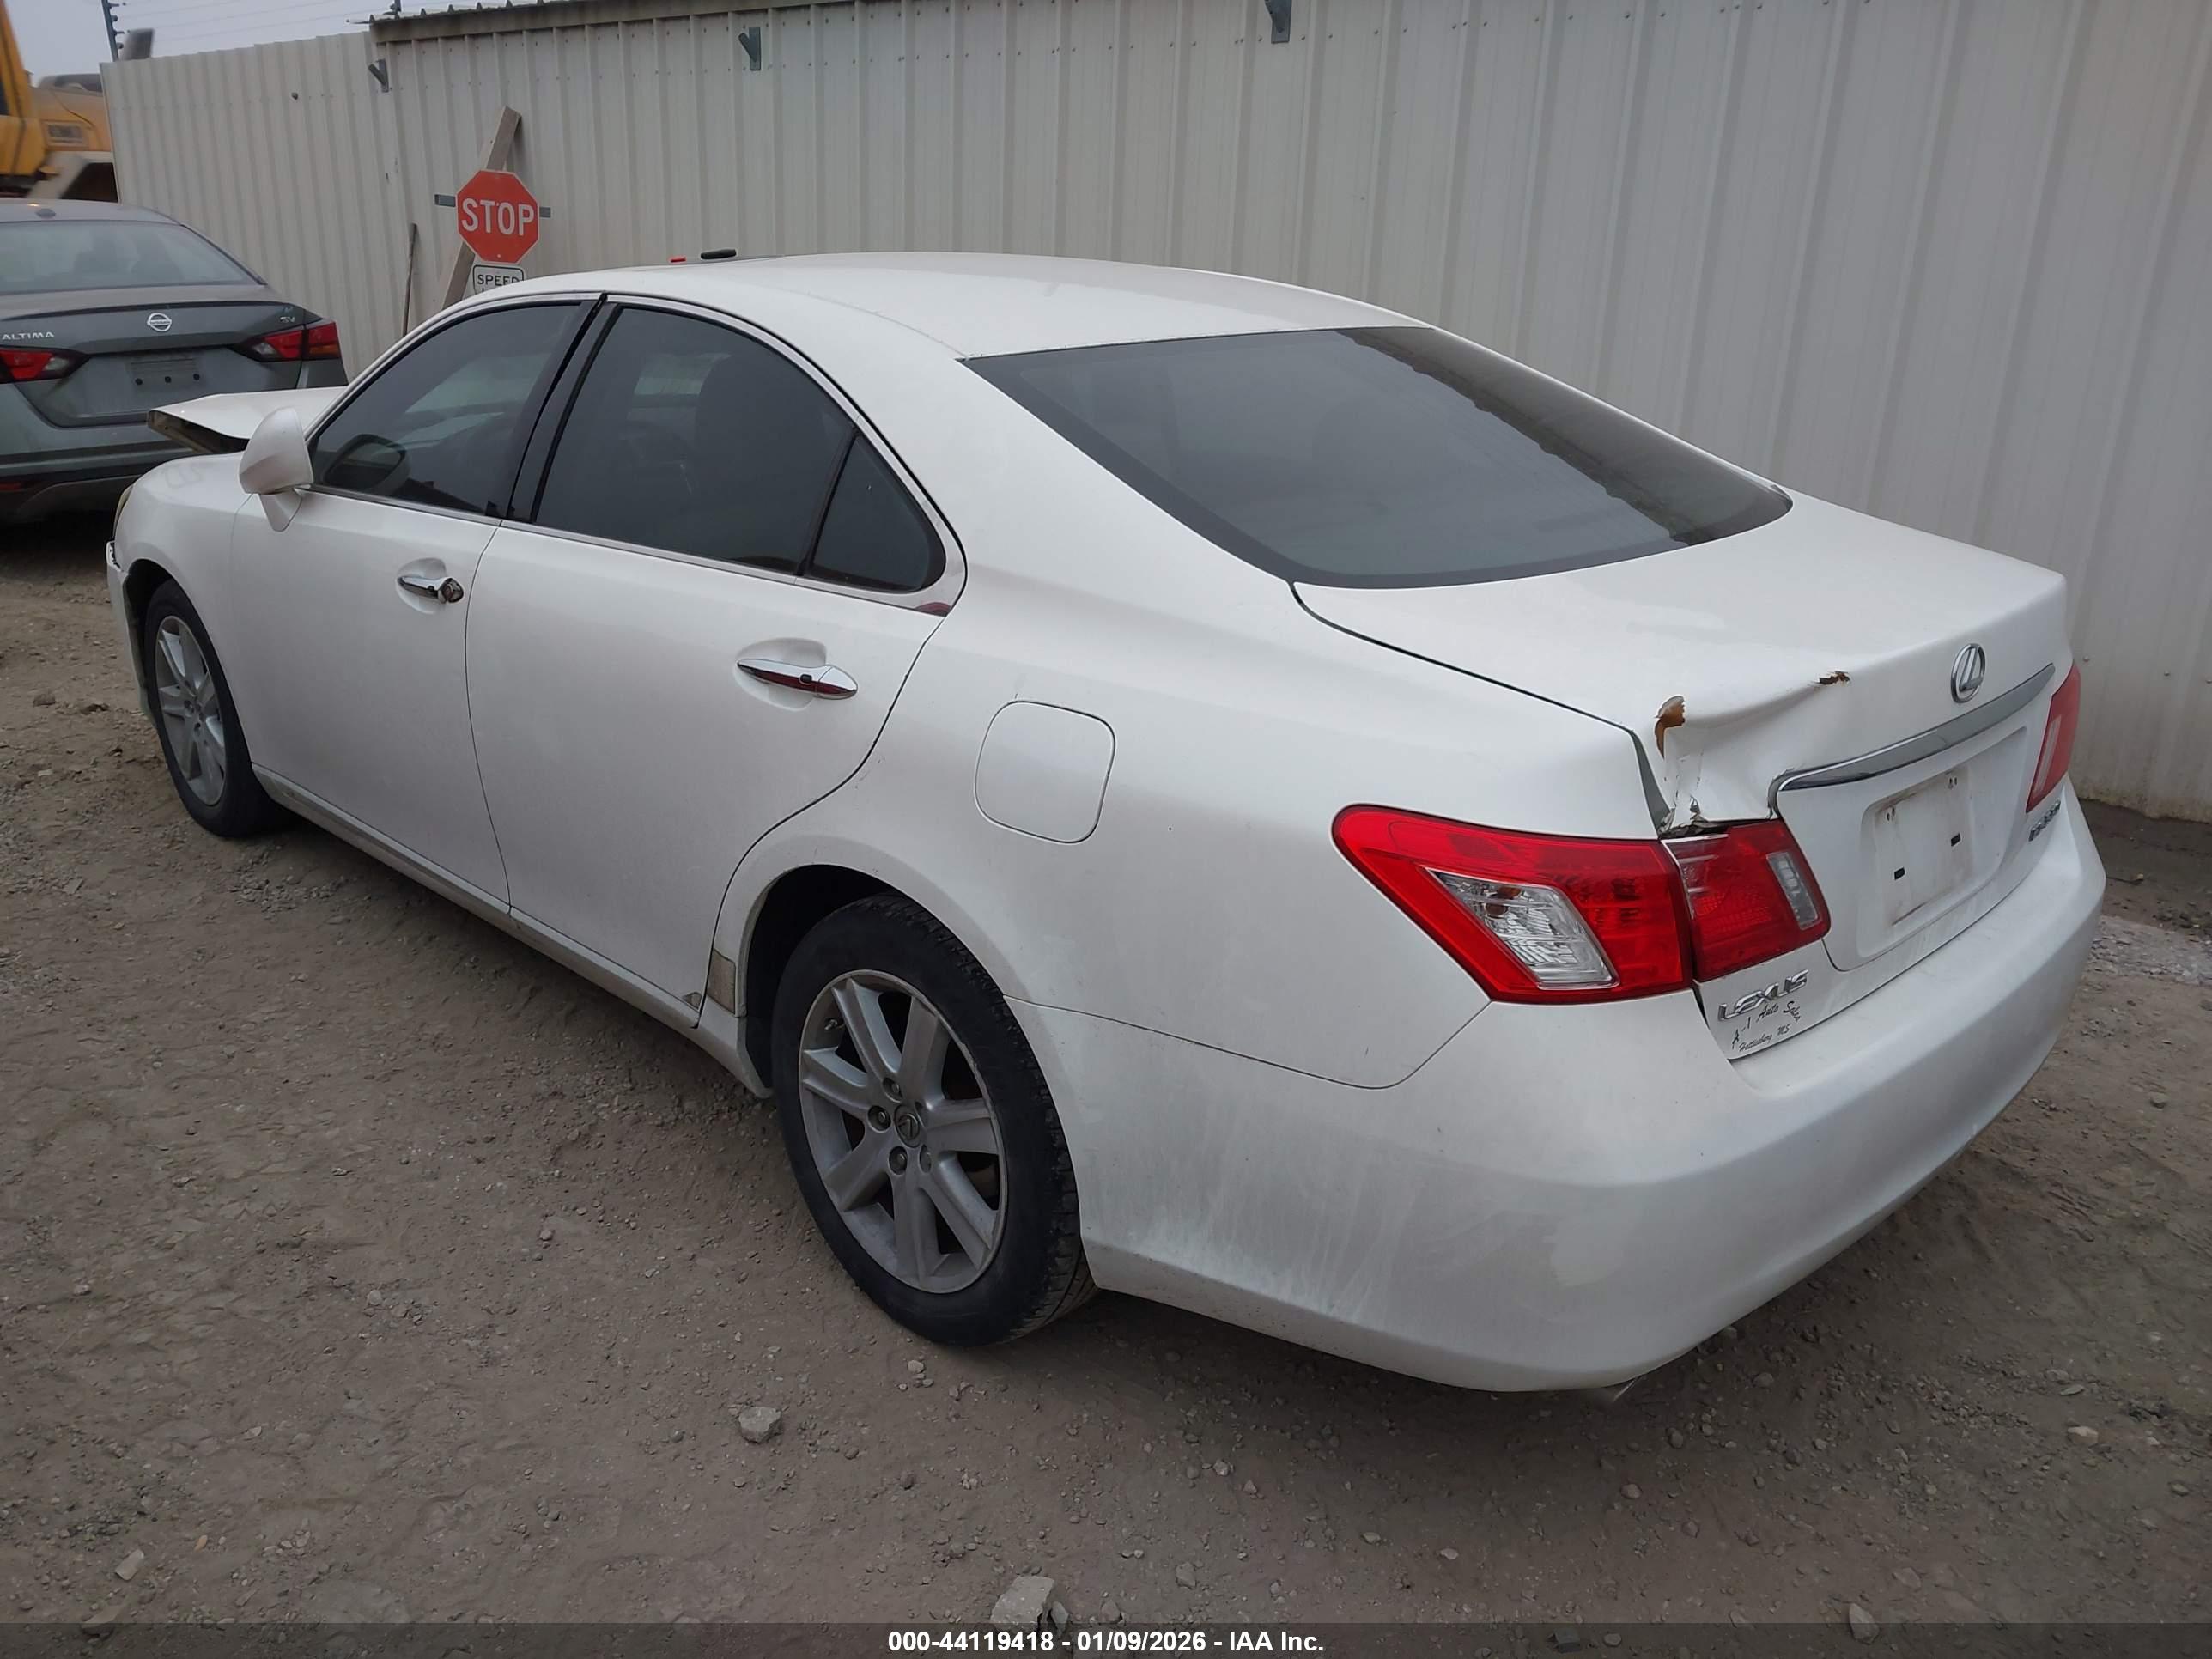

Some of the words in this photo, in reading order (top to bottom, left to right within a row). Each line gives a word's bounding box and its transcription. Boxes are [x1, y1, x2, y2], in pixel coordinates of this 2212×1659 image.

[461, 198, 535, 236] STOP
[477, 274, 520, 286] SPEED
[2, 331, 55, 340] ALTIMA
[1717, 969, 1808, 1021] LEXUS
[1756, 1003, 1779, 1023] Auto
